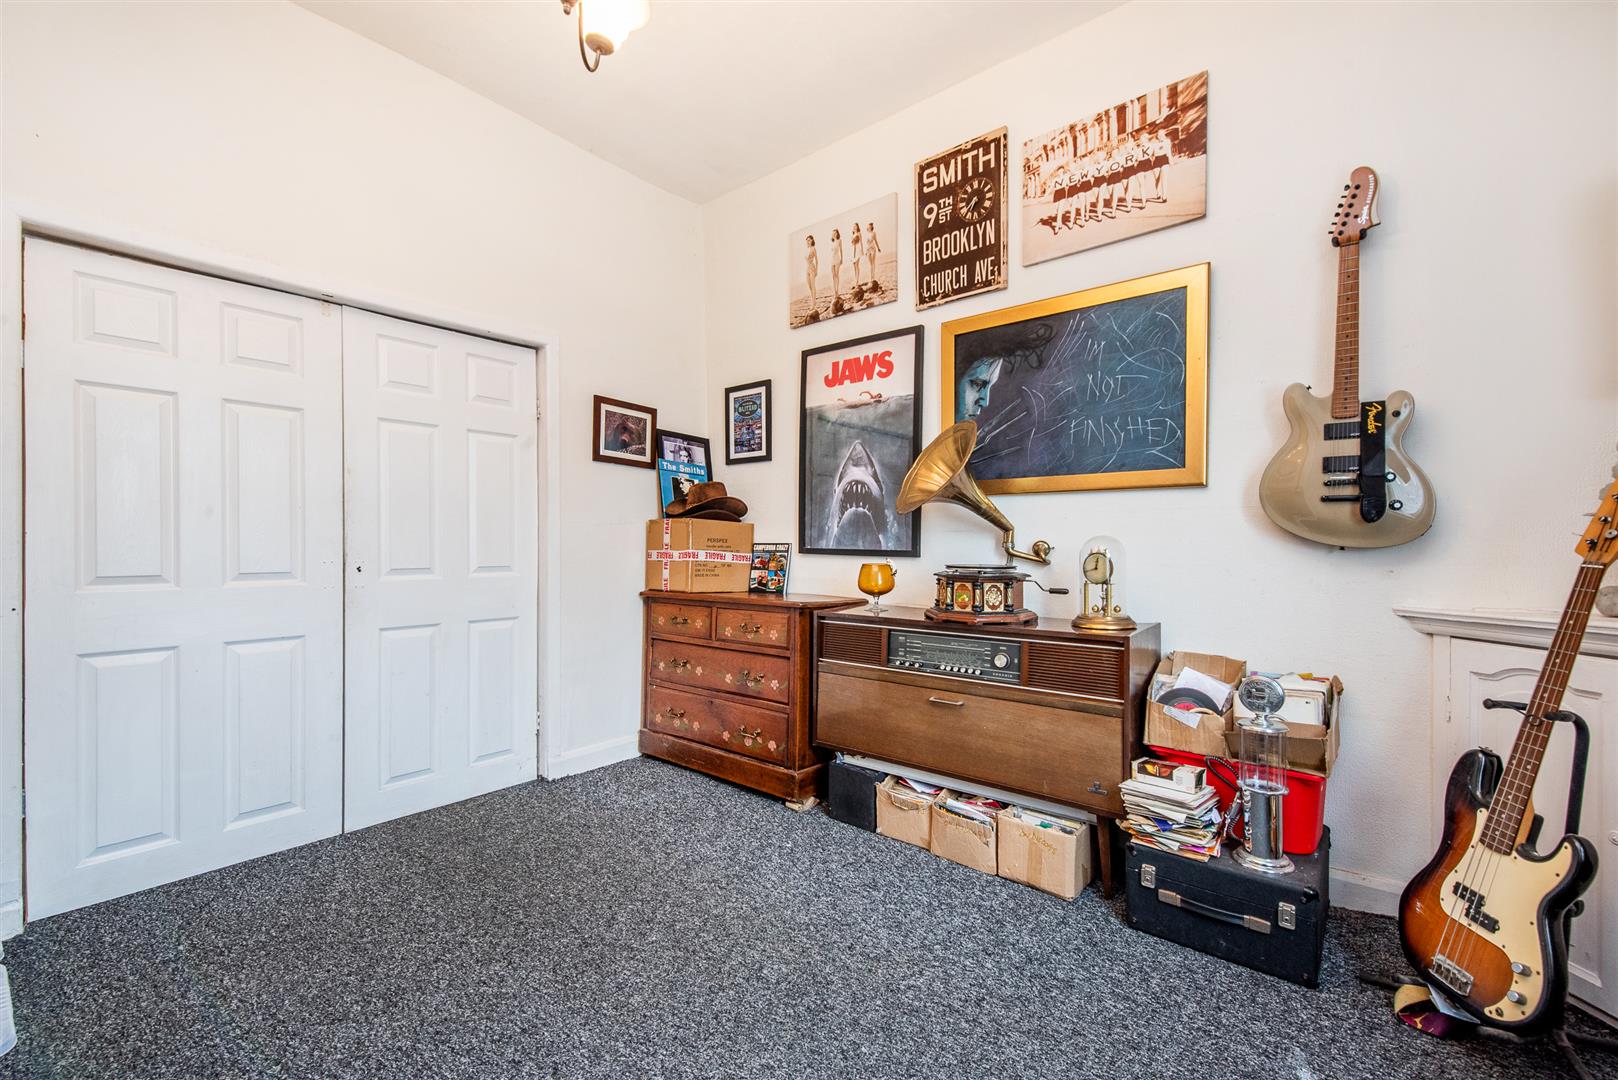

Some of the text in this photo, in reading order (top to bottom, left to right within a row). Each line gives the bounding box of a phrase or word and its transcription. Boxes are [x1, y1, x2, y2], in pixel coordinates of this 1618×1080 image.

[923, 142, 995, 193] SMITH
[923, 218, 995, 265] BROOKLYN
[923, 264, 968, 298] CHURCH
[824, 350, 894, 388] JAWS
[1086, 370, 1149, 403] NOT
[1070, 415, 1183, 450] FINISHED
[662, 461, 705, 475] The Smiths
[656, 551, 674, 560] FRAGILE
[678, 551, 699, 560] FRAGILE
[704, 551, 726, 561] FRAGILE
[731, 553, 751, 562] FRAGILE
